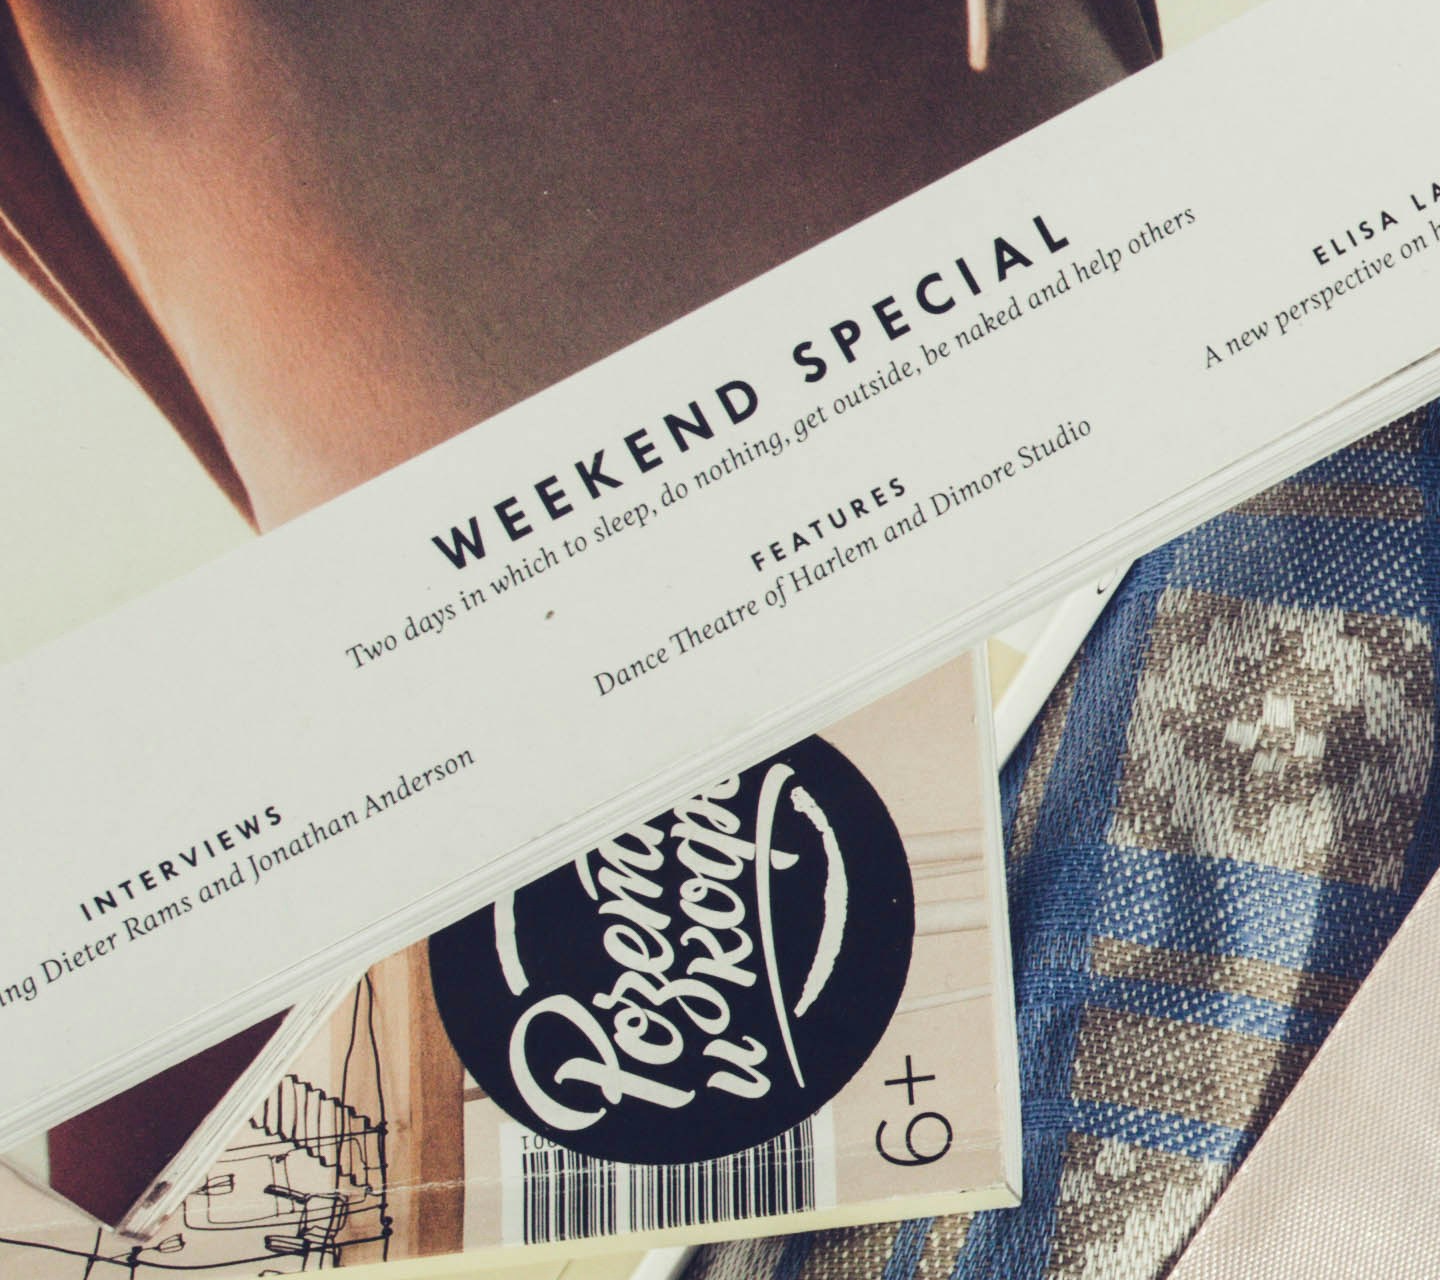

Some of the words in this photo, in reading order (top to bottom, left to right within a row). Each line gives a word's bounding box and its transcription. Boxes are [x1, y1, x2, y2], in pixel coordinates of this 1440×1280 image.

[1205, 344, 1224, 369] A
[1224, 320, 1269, 356] new
[1273, 252, 1396, 336] perspective
[1399, 234, 1429, 260] on
[1311, 210, 1400, 267] ELISA
[344, 634, 398, 669] Two
[404, 603, 457, 641] days
[459, 588, 488, 612] in
[489, 546, 560, 595] which
[562, 535, 588, 558] to
[593, 503, 658, 543] sleep,
[660, 481, 689, 508] do
[693, 431, 791, 489] nothing,
[793, 405, 829, 444] get
[833, 360, 922, 415] outside,
[919, 341, 951, 367] be
[953, 295, 1024, 349] naked
[1027, 268, 1072, 310] and
[1070, 248, 1123, 284] help
[1127, 208, 1196, 255] others
[430, 379, 759, 571] WEEKEND
[791, 214, 1071, 384] SPECIAL
[592, 647, 670, 697] Dance
[668, 599, 760, 656] Theatre
[764, 575, 787, 609] of
[788, 536, 879, 593] Harlem
[883, 501, 929, 544] and
[928, 461, 1017, 518] Dimore
[1017, 420, 1091, 469] Studio
[749, 476, 906, 573] FEATURES
[39, 932, 118, 985] Dieter
[121, 895, 193, 942] Rams
[198, 861, 246, 904] and
[246, 810, 360, 885] Jonathan
[365, 749, 475, 820] Anderson
[79, 805, 283, 922] INTERVIEWS
[509, 817, 730, 1131] Розет
[703, 1035, 768, 1100] и
[876, 1055, 953, 1166] 6+
